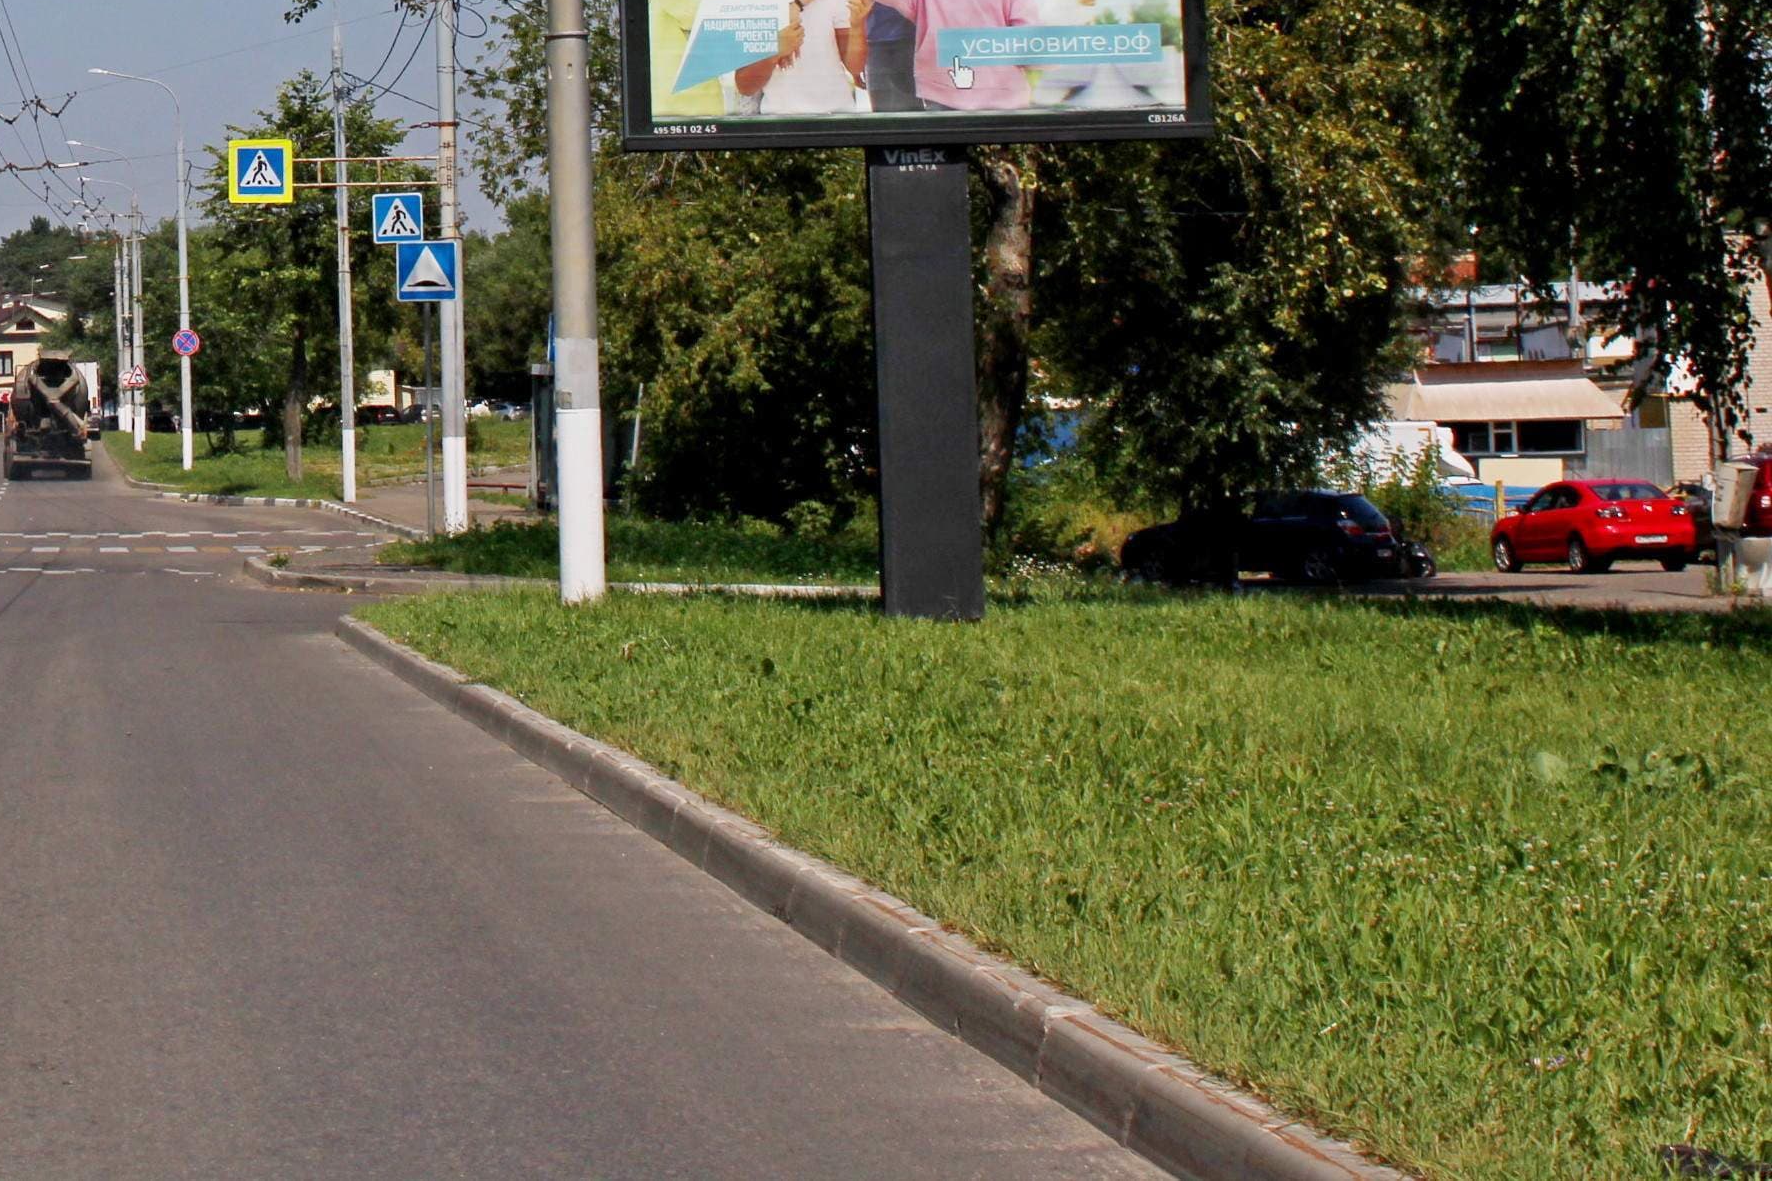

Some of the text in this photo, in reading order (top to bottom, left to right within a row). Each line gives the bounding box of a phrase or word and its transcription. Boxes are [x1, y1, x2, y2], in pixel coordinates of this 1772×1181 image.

[703, 19, 778, 31] НАЦИОНАЛЬНЫЕ
[735, 30, 778, 41] ПРОЕКТЫ
[961, 30, 1152, 57] усыновите.рф
[884, 148, 946, 164] VinEx
